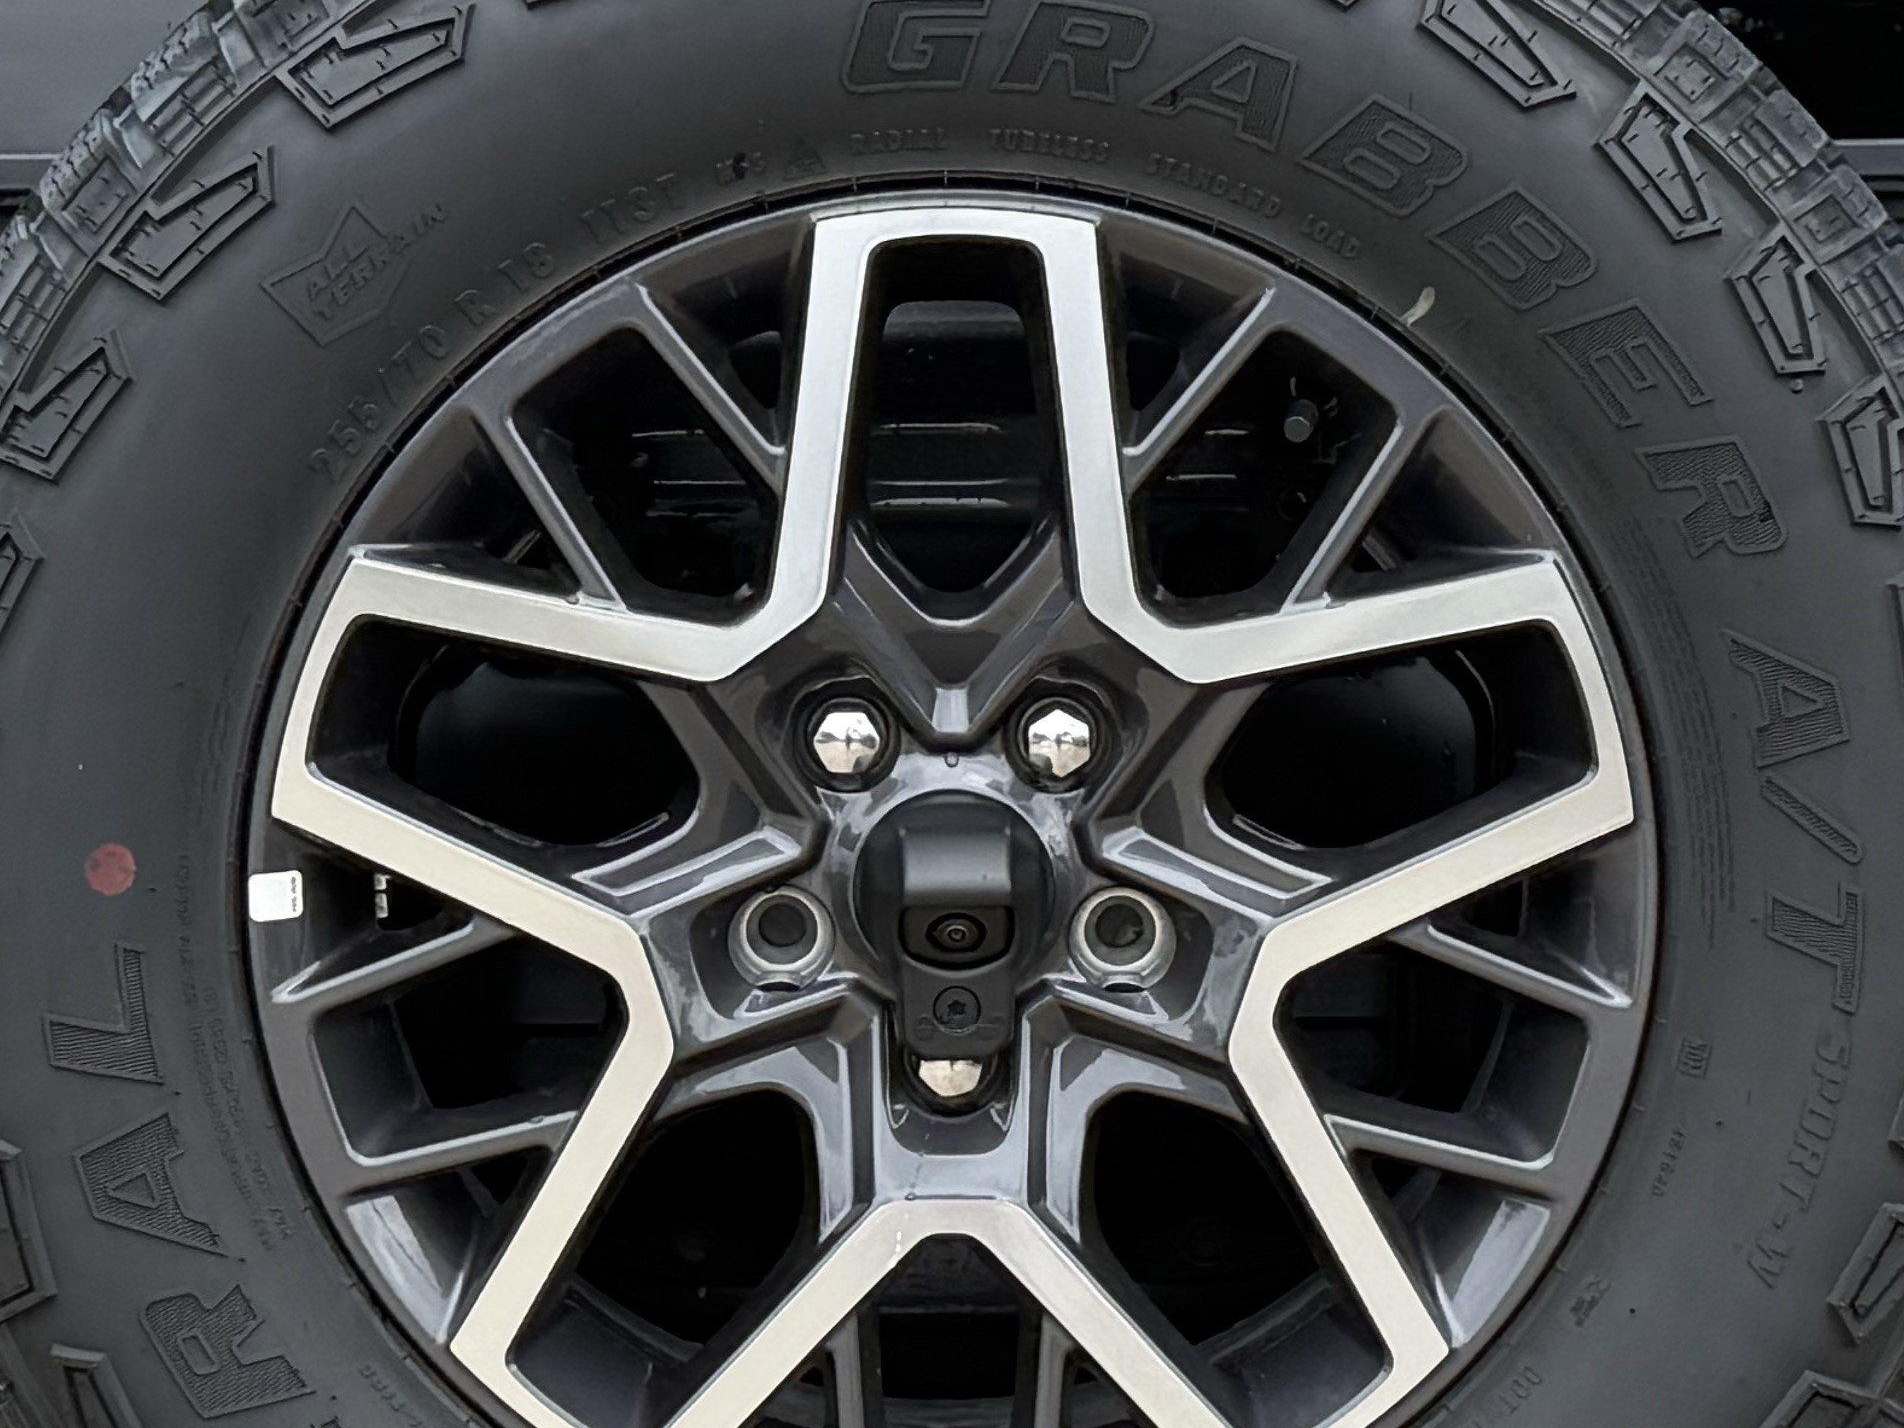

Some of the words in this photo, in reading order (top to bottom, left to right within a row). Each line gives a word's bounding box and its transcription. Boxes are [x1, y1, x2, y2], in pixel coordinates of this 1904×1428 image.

[312, 203, 447, 320] TERRAIN
[1148, 151, 1281, 219] STANDARD
[1301, 211, 1363, 261] LOAD
[310, 324, 448, 476] 255/70
[1719, 627, 1866, 1017] A/T
